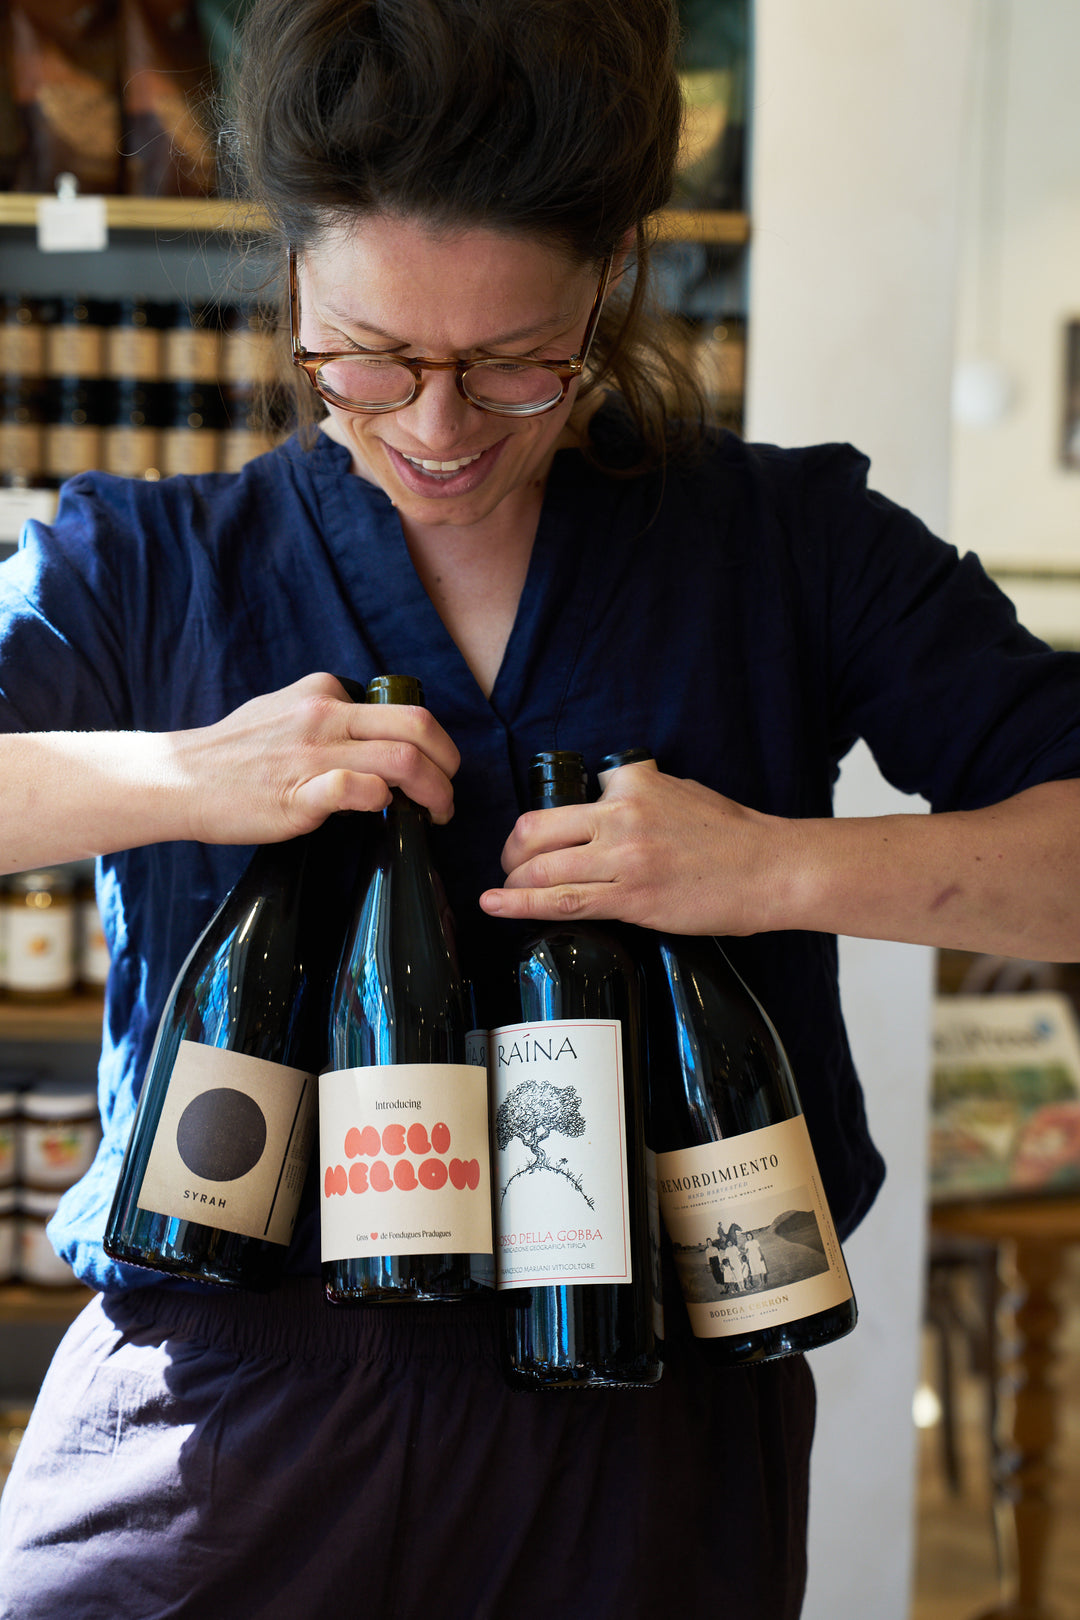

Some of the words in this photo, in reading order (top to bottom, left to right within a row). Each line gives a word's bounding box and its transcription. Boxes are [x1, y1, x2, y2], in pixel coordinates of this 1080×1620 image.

[498, 1033, 578, 1067] RAÍNA
[375, 1099, 422, 1110] Introducing
[324, 1157, 480, 1199] MELLOW
[661, 1153, 779, 1193] REMORDIMIENTO
[183, 1189, 227, 1209] SYRAH
[687, 1191, 705, 1200] HAND
[356, 1233, 369, 1242] Gros
[380, 1232, 388, 1240] de
[389, 1231, 421, 1240] Fondugues
[421, 1229, 452, 1239] Pradugues
[519, 1231, 554, 1245] DELLA
[556, 1229, 603, 1242] GOBBA
[529, 1243, 566, 1252] GEOGRAFICA
[524, 1264, 551, 1273] MARIANI
[552, 1262, 596, 1271] VITICOLTORE
[709, 1305, 745, 1319] BODEGA
